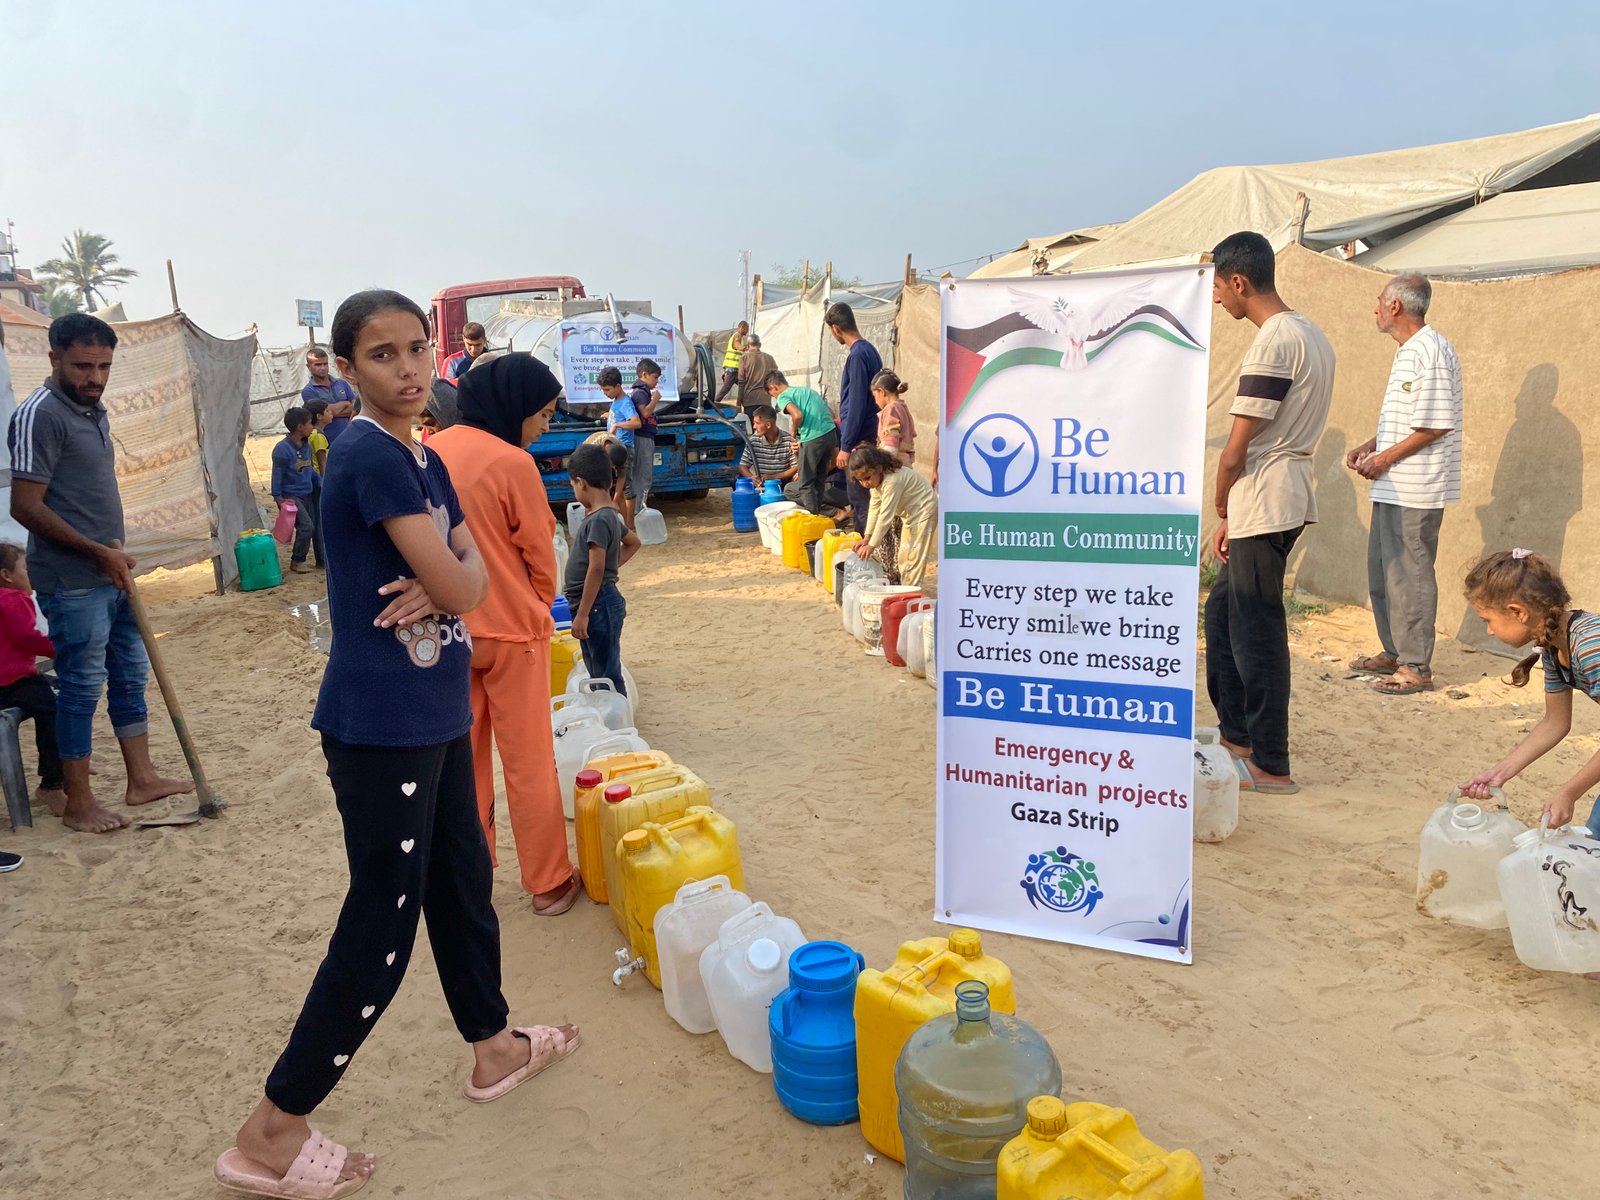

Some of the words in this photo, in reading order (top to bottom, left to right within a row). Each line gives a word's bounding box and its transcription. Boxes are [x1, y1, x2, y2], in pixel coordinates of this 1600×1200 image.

[570, 356, 590, 364] Every
[618, 345, 655, 354] Community
[1051, 418, 1110, 458] Be
[1051, 462, 1186, 496] Human
[945, 523, 973, 546] Be
[978, 524, 1056, 548] Human
[1063, 525, 1197, 557] Community
[965, 578, 1027, 605] Every
[1033, 584, 1078, 607] step
[1085, 588, 1117, 605] we
[1125, 585, 1174, 607] take
[959, 609, 1020, 634] Every
[1080, 619, 1112, 637] we
[1119, 617, 1181, 645] bring
[957, 638, 1032, 664] Carries
[1039, 649, 1079, 666] one
[1086, 654, 1182, 677] message
[955, 676, 1005, 710] Be
[1020, 682, 1178, 725] Human
[994, 737, 1113, 772] Emergency
[1118, 749, 1135, 770] &
[945, 763, 1088, 797] Humanitarian
[1098, 783, 1188, 810] projects
[1010, 802, 1062, 826] Gaza
[1067, 808, 1120, 837] Strip
